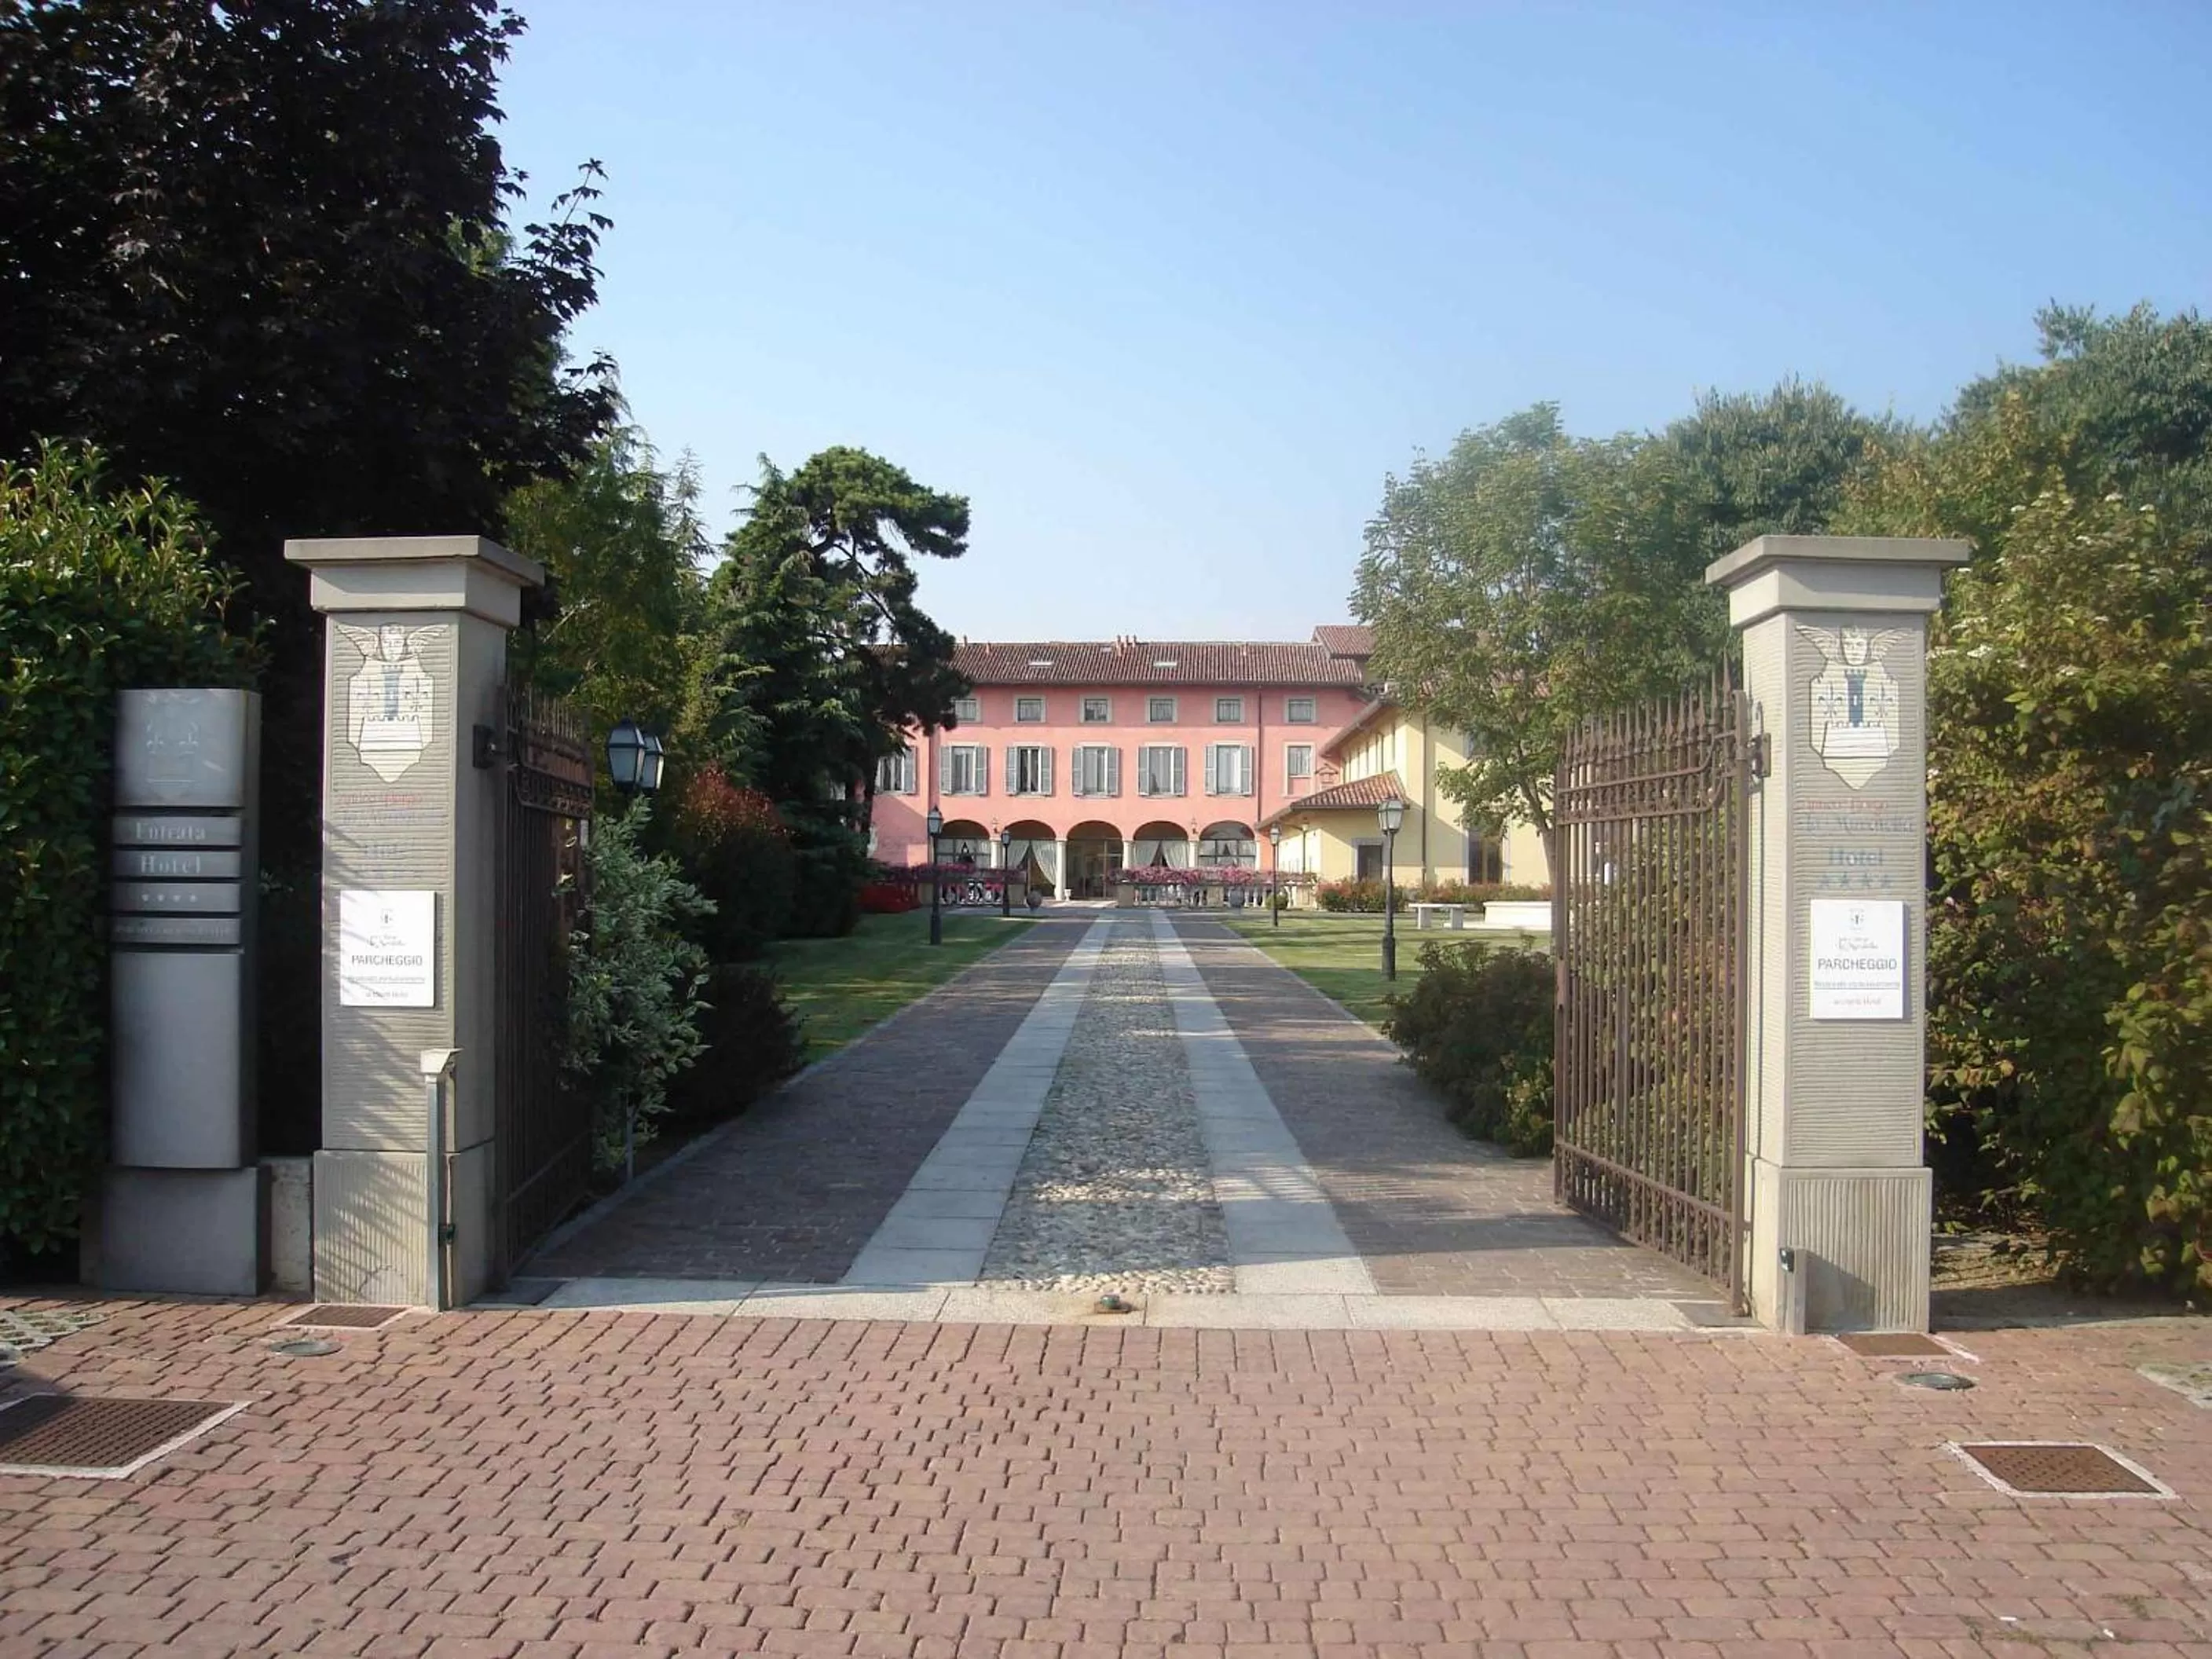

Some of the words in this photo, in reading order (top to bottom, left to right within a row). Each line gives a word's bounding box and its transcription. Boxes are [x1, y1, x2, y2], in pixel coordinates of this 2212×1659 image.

[141, 855, 201, 873] Hotel
[351, 954, 423, 965] PARCHEGGIO
[1817, 958, 1898, 970] PARCHEGGIO
